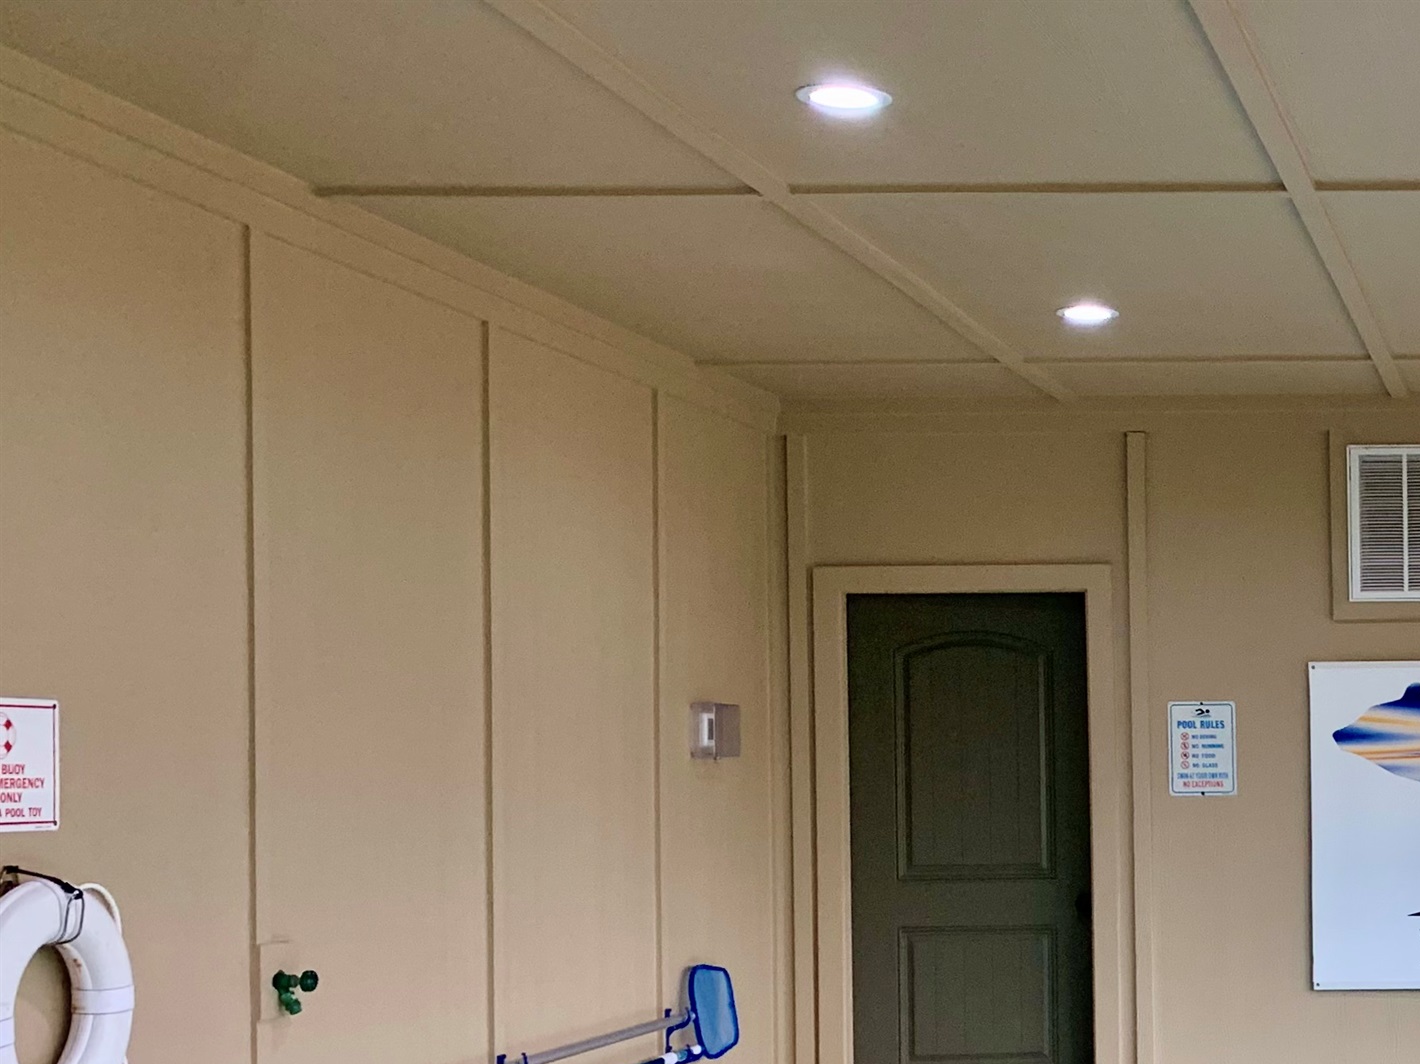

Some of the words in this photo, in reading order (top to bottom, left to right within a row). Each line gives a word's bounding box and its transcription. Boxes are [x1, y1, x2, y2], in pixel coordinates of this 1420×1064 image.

[1177, 720, 1197, 729] POOL
[1200, 720, 1225, 729] RULES
[1, 764, 25, 775] BUOY
[0, 792, 23, 803] ONLY
[5, 808, 25, 817] POOL
[28, 807, 42, 817] TOY
